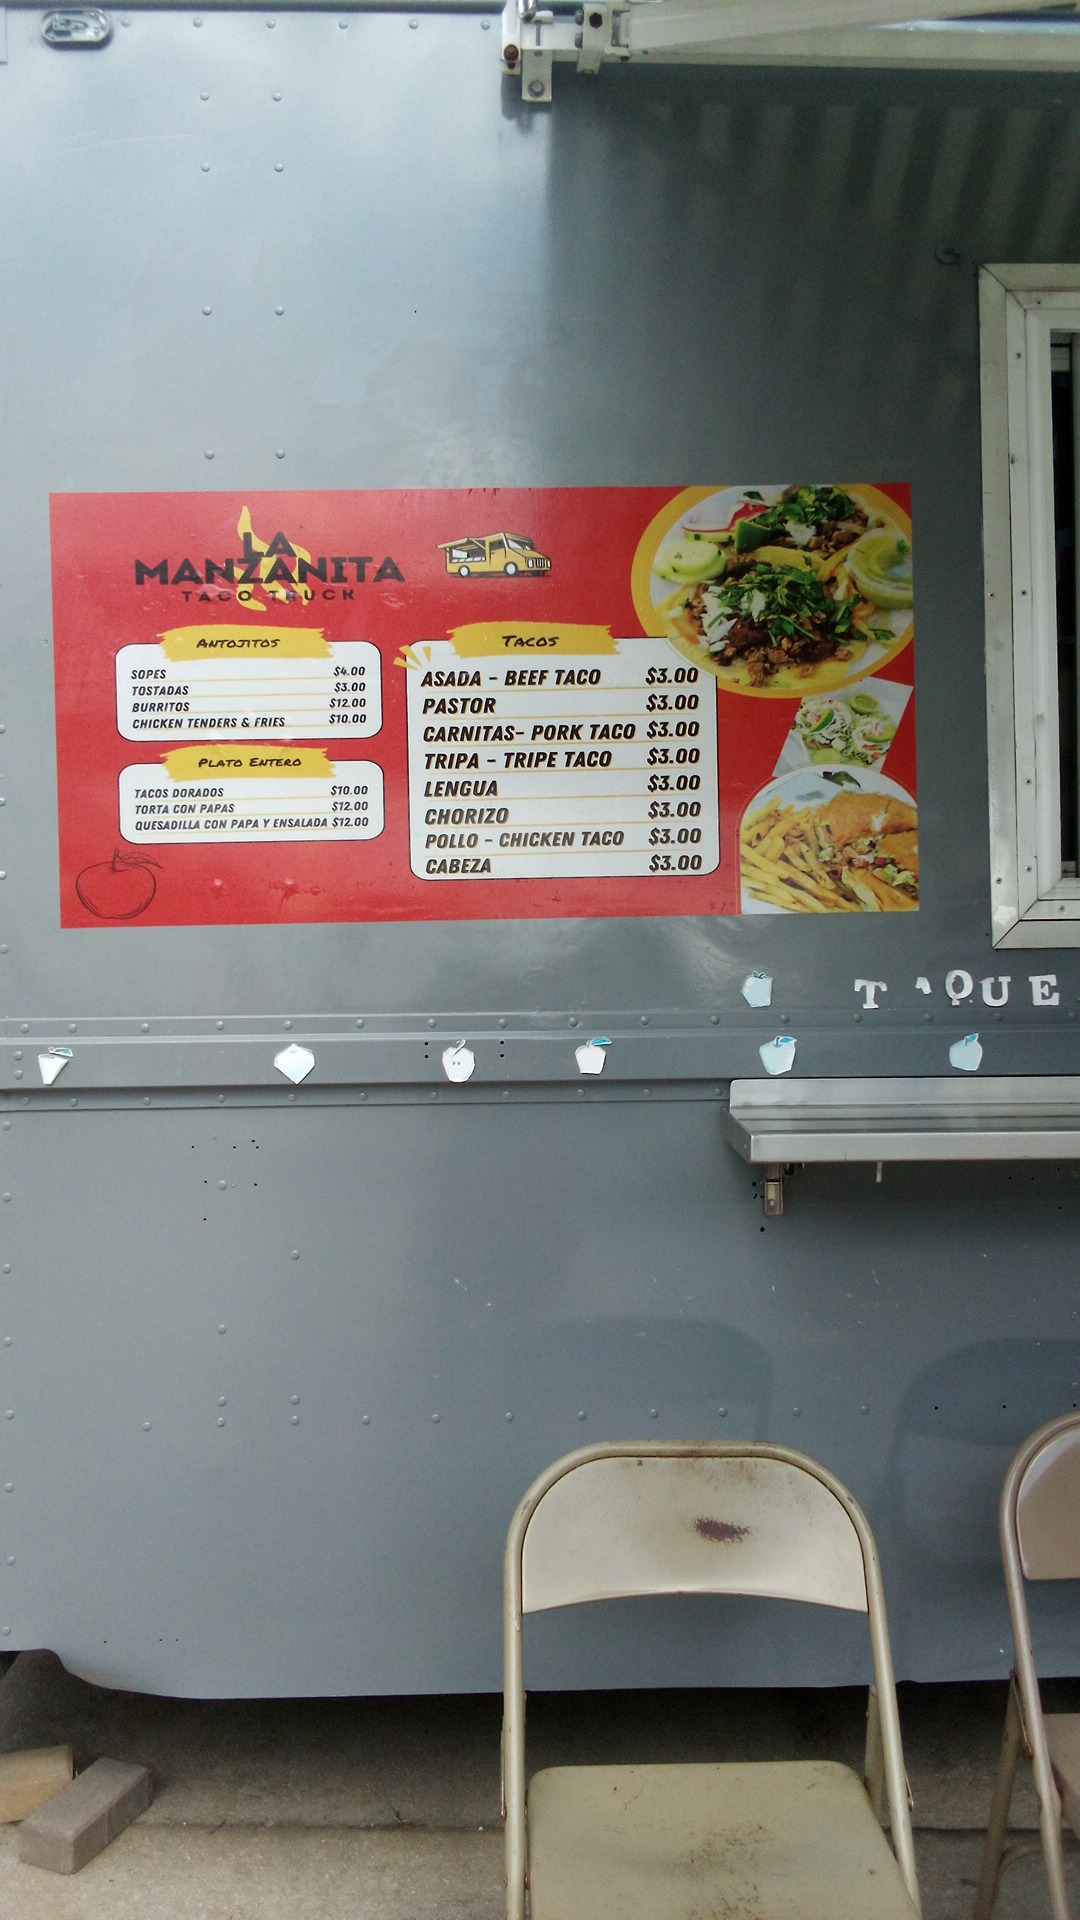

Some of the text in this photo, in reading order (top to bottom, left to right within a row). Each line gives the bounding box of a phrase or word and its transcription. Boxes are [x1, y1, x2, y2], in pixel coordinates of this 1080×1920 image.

[243, 532, 297, 557] LA
[134, 556, 405, 585] MANZANITA
[182, 589, 356, 602] TACO TRUCK
[502, 635, 559, 647] TACOS
[131, 667, 365, 680] SOPES $4.00
[421, 670, 481, 687] ASADA
[504, 670, 548, 685] BEEF
[554, 669, 601, 684] TACO
[645, 667, 698, 684] $3.00
[132, 683, 365, 696] TOSTADAS $3.00
[132, 699, 366, 712] BURRITOS $12.00
[422, 694, 699, 714] PASTOR $3.00
[132, 714, 366, 729] CHICKEN TENDERS & FRIES $10.00
[531, 724, 582, 741] PORK
[589, 723, 635, 739] TACO
[646, 721, 699, 738] $3.00
[198, 758, 302, 768] PLATO ENTERO
[424, 753, 479, 769] TRIPA
[504, 752, 557, 768] TRIPE
[564, 751, 612, 767] TACO
[647, 748, 700, 765] $3.00
[134, 786, 368, 798] TACOS DORADOS $10.00
[424, 775, 700, 797] LENGUA $3.00
[135, 802, 368, 815] TORTA CON PAPAS $12.00
[424, 802, 701, 825] CHORIZO $3.00
[135, 817, 369, 831] QUESADILLA CON PAPA Y ENSALADA $12.00
[425, 834, 478, 849] POLLO
[499, 832, 575, 847] CHICKEN
[581, 831, 624, 846] TACO
[649, 828, 701, 844] $3.00
[426, 855, 702, 874] CABEZA $3.00
